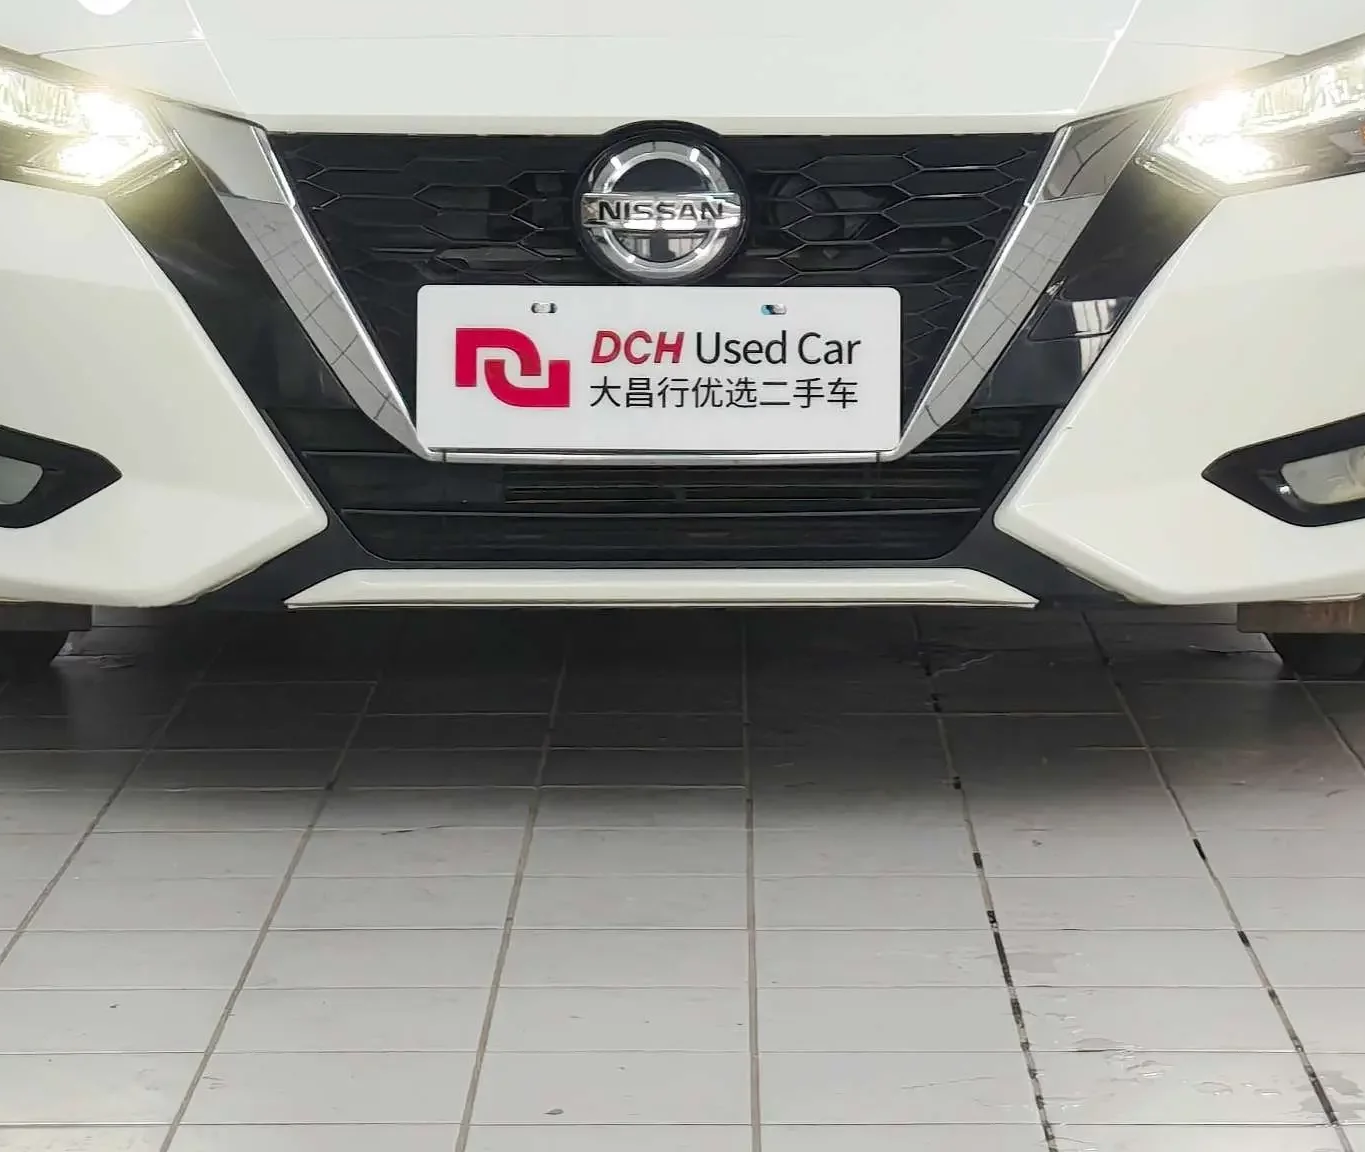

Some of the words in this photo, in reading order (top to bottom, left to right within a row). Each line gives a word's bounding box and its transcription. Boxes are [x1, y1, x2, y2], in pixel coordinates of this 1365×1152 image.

[598, 200, 724, 221] NISSAN
[590, 330, 685, 365] DCH
[696, 329, 787, 365] Used
[797, 331, 862, 365] Car
[589, 375, 859, 409] 大昌行优选二手车
